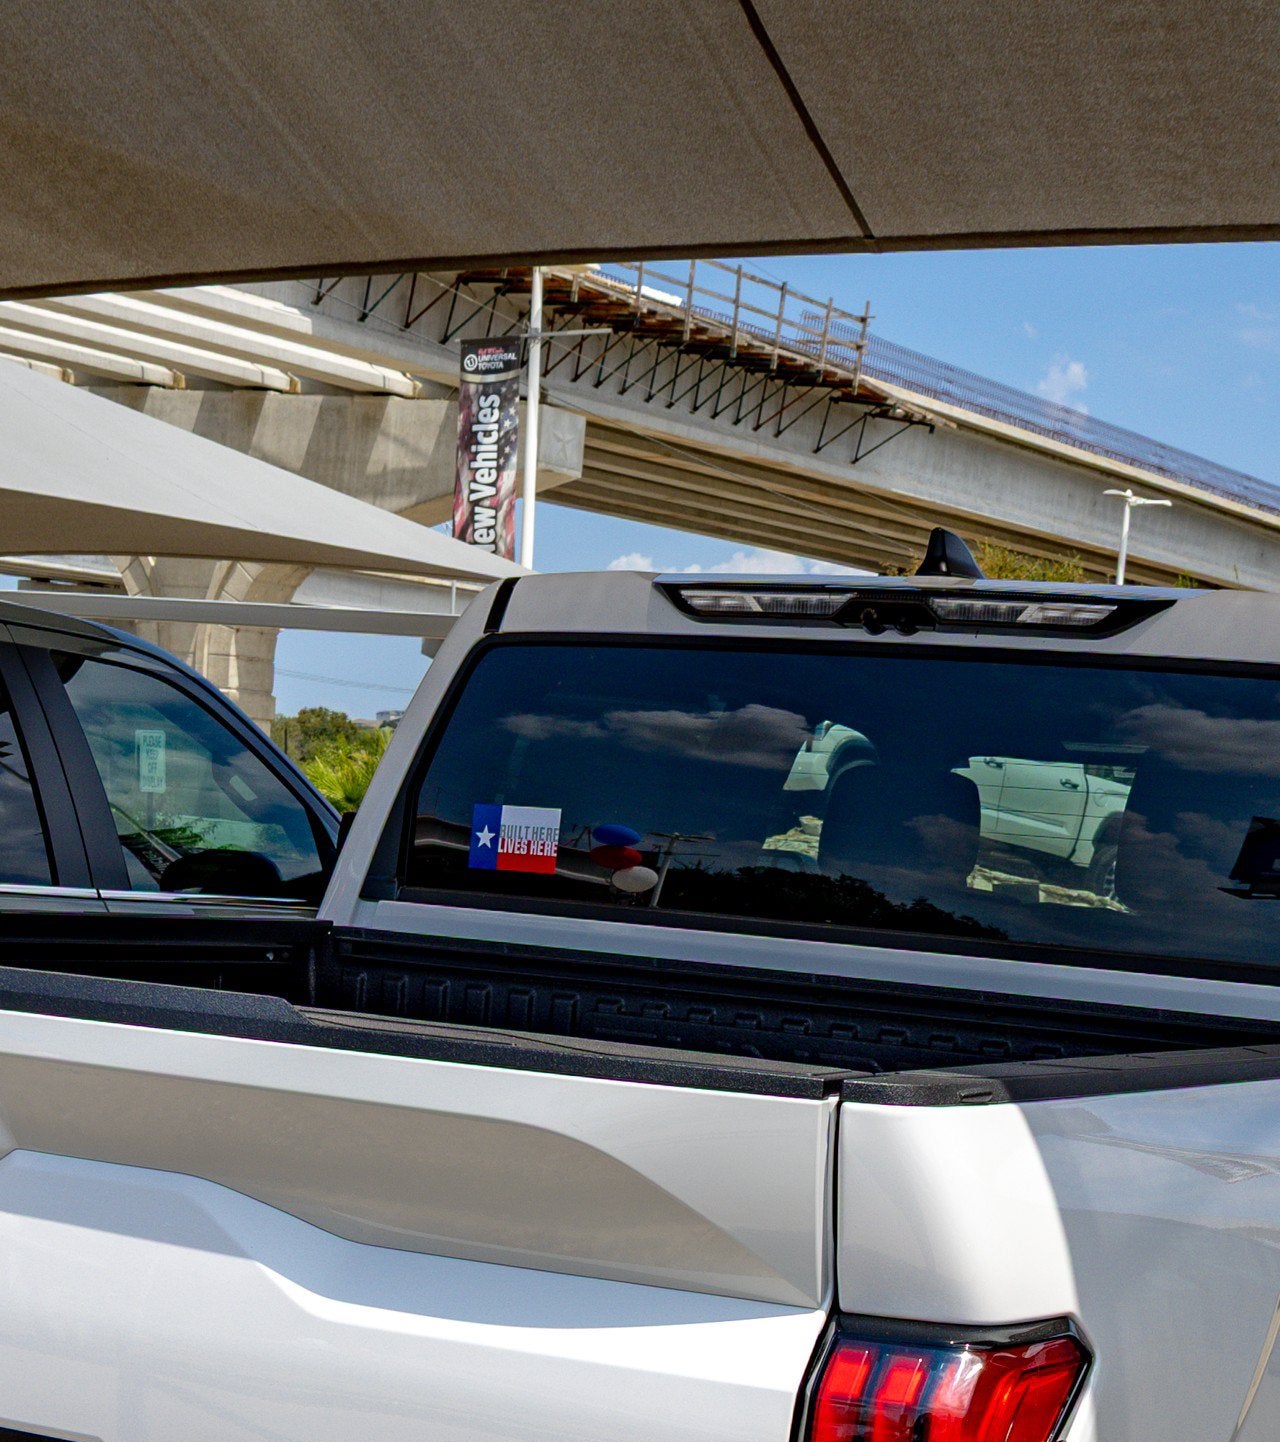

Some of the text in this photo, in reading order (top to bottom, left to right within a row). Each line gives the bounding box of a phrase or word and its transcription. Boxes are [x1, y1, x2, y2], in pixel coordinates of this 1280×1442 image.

[478, 352, 517, 363] UNIVERSAL
[478, 361, 504, 371] TOYOTA
[469, 394, 501, 554] ew Vehicles
[500, 825, 560, 842] BUILT HERE
[498, 838, 558, 857] LIVES HERE
